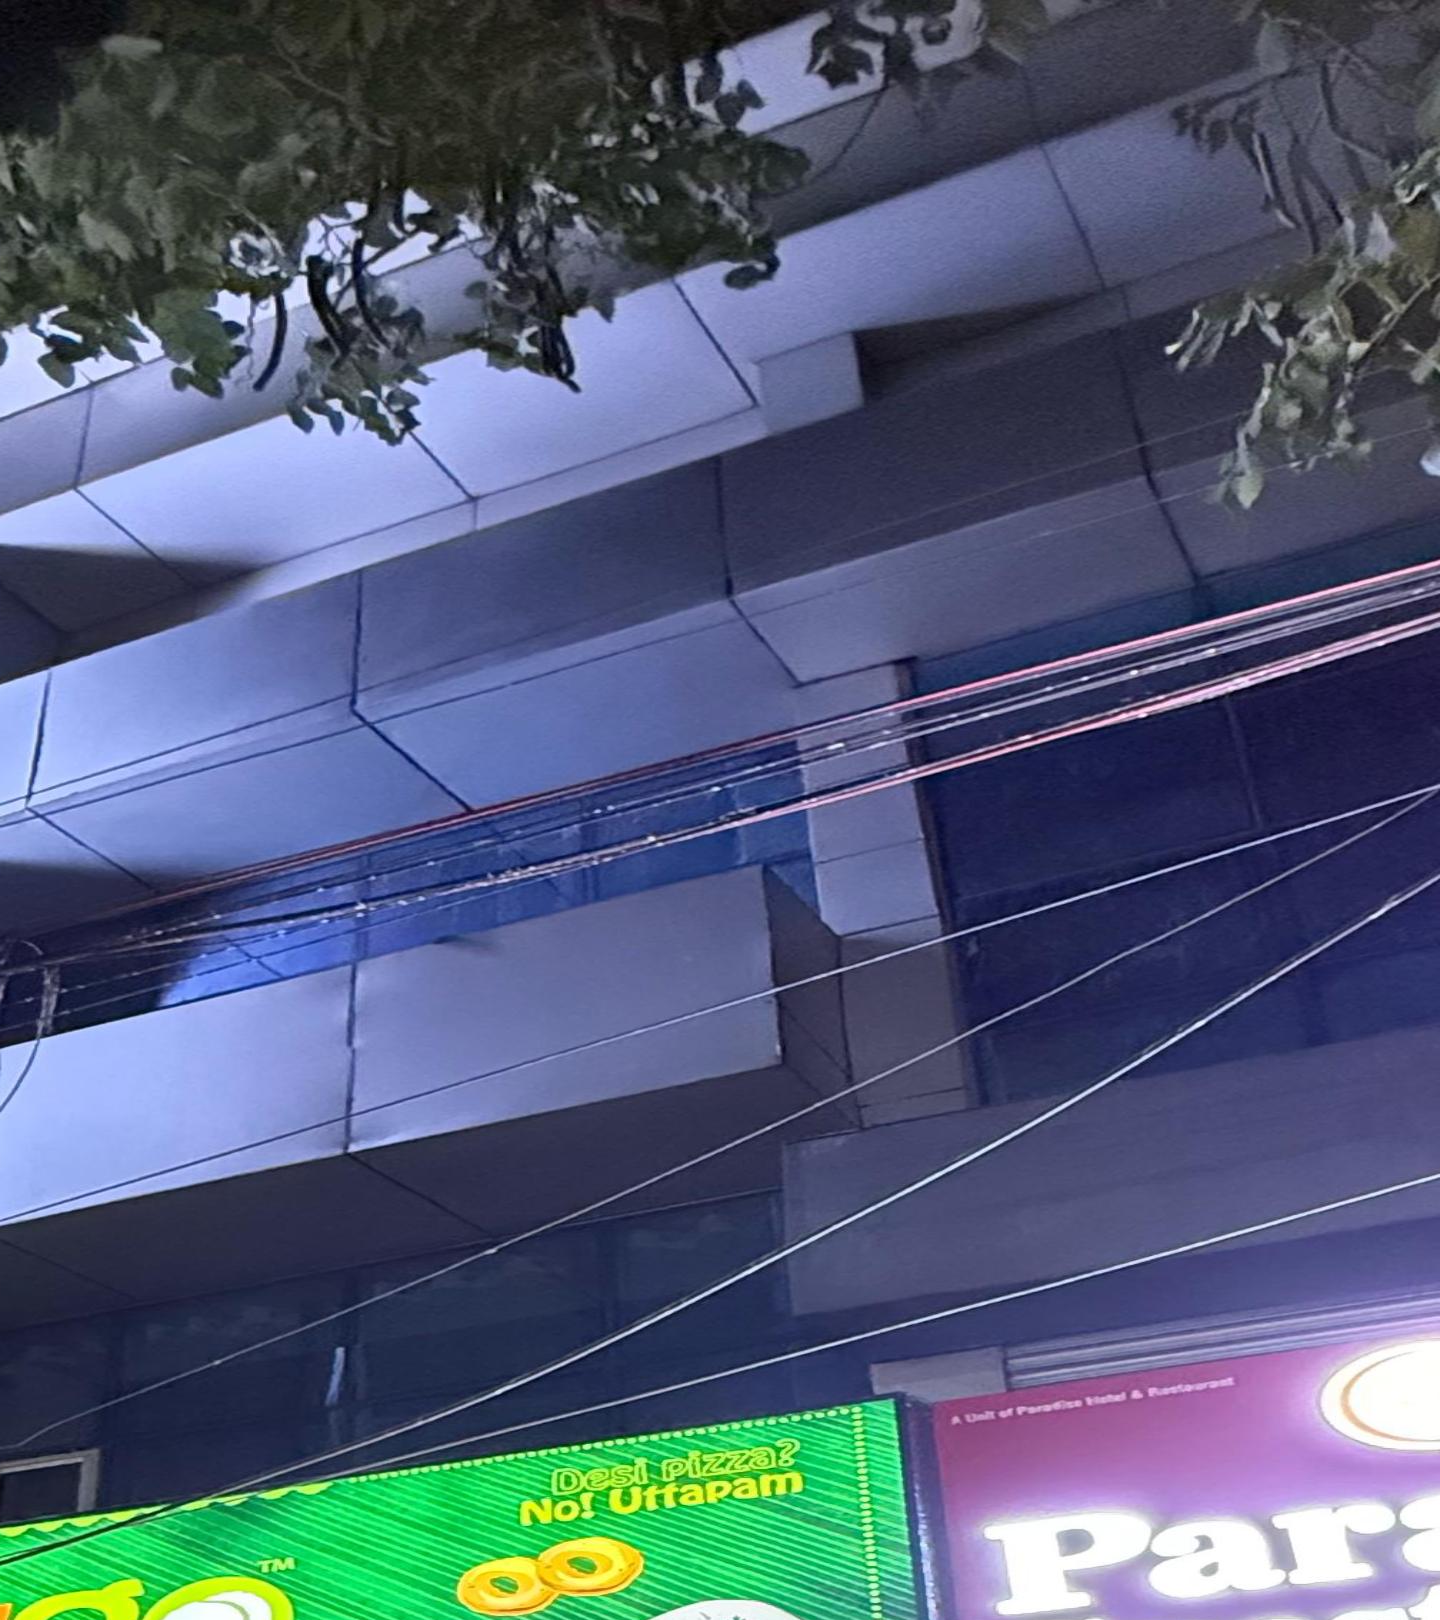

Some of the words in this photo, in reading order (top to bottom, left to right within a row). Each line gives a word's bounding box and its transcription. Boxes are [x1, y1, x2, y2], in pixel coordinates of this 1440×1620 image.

[550, 1457, 649, 1495] Desi
[661, 1438, 801, 1483] pizza?
[519, 1492, 596, 1526] No!
[609, 1471, 805, 1514] Uttapam
